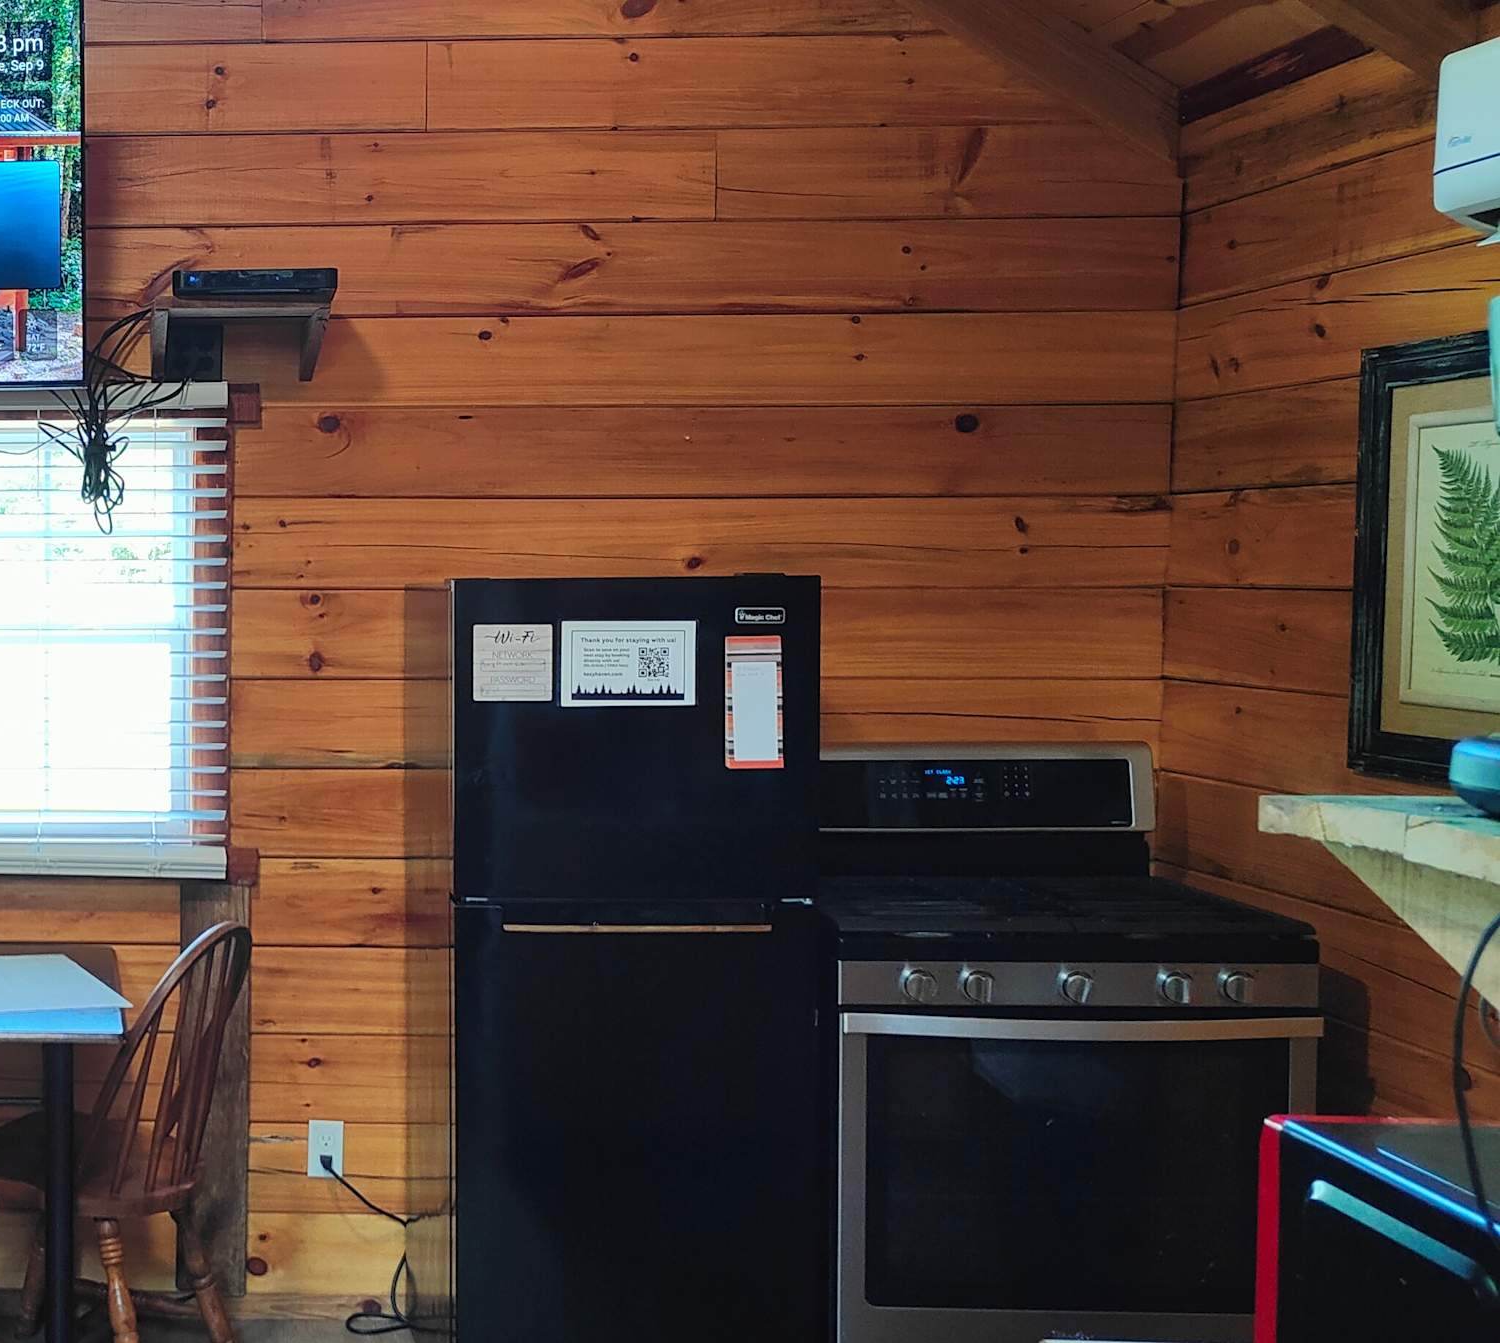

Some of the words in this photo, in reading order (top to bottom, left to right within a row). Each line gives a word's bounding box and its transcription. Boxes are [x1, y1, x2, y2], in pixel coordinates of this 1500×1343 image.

[13, 37, 43, 55] pm
[11, 60, 33, 73] Sep
[36, 60, 44, 71] 9
[22, 99, 45, 108] OUT:
[13, 114, 29, 122] AM
[485, 630, 540, 644] Wi-Fi
